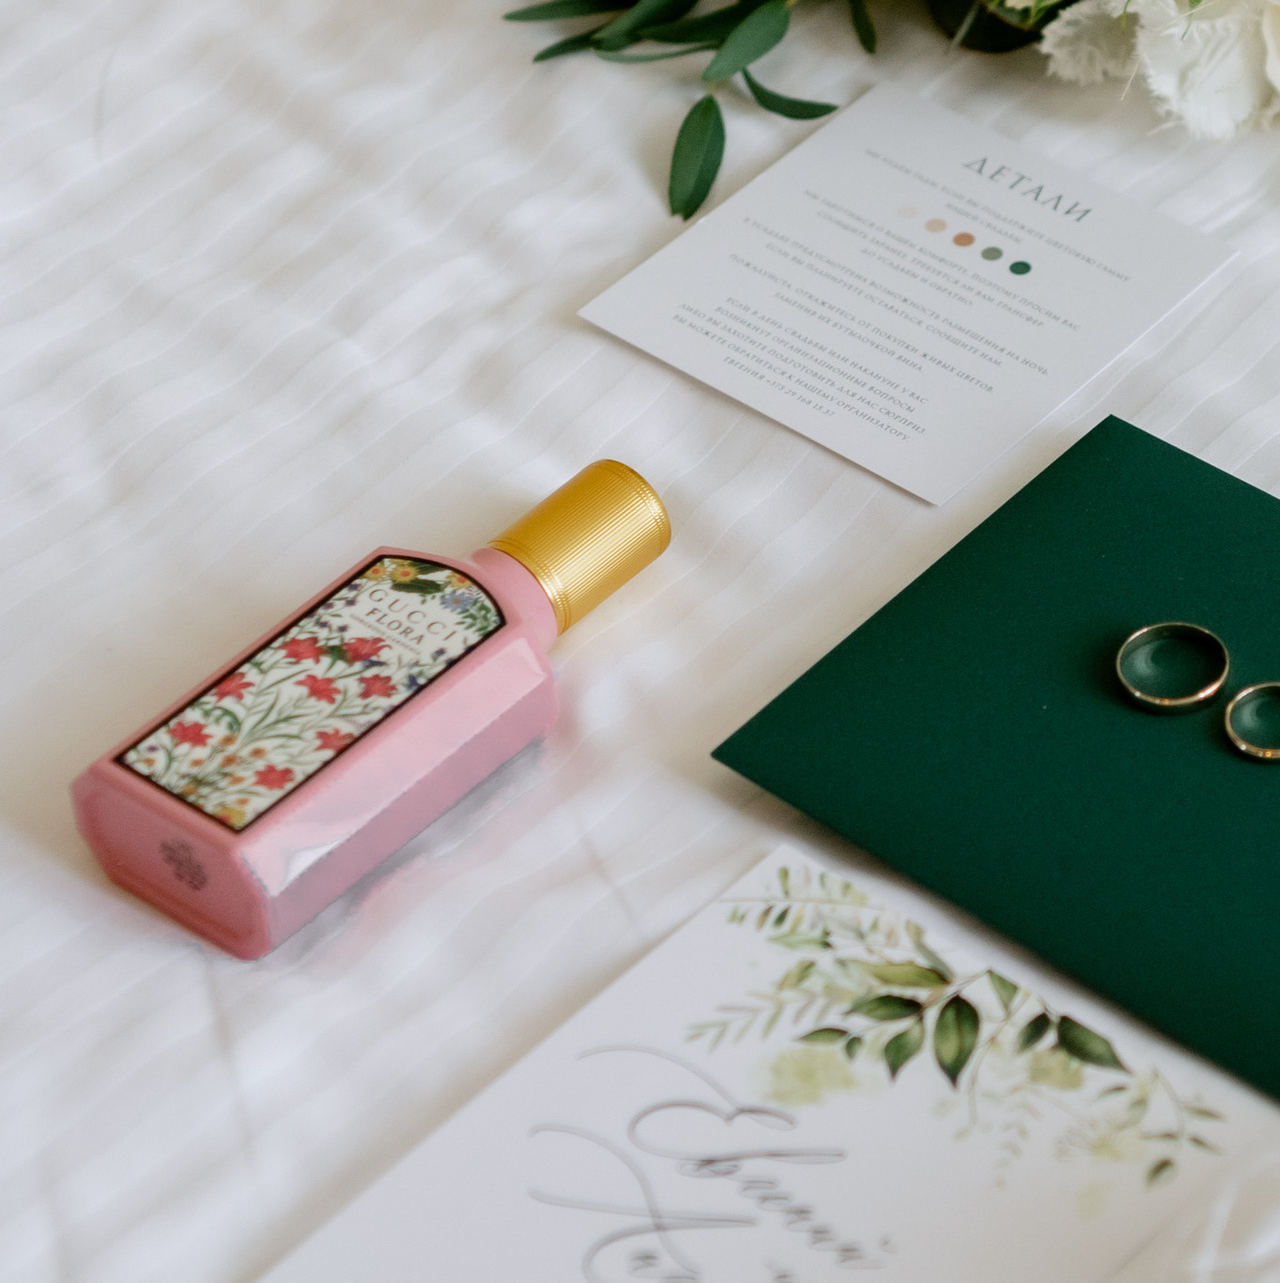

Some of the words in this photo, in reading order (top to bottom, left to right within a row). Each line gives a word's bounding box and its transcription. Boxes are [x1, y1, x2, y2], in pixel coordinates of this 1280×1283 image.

[962, 156, 1093, 224] ДЕТАЛИ
[670, 313, 689, 325] ВЫ
[685, 320, 728, 345] МОЖЕТЕ
[724, 341, 789, 377] ОБРАТИТЬСЯ
[792, 377, 837, 403] НАШЕМУ
[677, 302, 708, 320] ЛИБО
[703, 316, 722, 328] ВЫ
[719, 324, 768, 352] ЗАХОТИТЕ
[765, 348, 838, 388] ПОДГОТОВИТЬ
[834, 384, 859, 399] ДЛЯ
[854, 394, 879, 410] НАС
[723, 296, 753, 313] ЕСЛИ
[756, 313, 786, 330] ДЕНЬ
[781, 326, 829, 353] СВАДЬБЫ
[825, 348, 851, 364] ИЛИ
[847, 360, 902, 390] НАКАНУНЕ
[906, 390, 929, 404] ВАС
[771, 290, 819, 317] ЗАМЕНИВ
[815, 313, 834, 325] ИХ
[829, 320, 897, 358] БУТЫЛОЧКОЙ
[712, 305, 773, 338] ВОЗНИКНУТ
[769, 334, 869, 388] ОРГАНИЗАЦИОННЫЕ
[865, 384, 917, 414] ВОПРОСЫ
[721, 355, 767, 381] ЕВГЕНИЯ
[365, 607, 425, 646] FLORA
[368, 588, 456, 641] GUCCI
